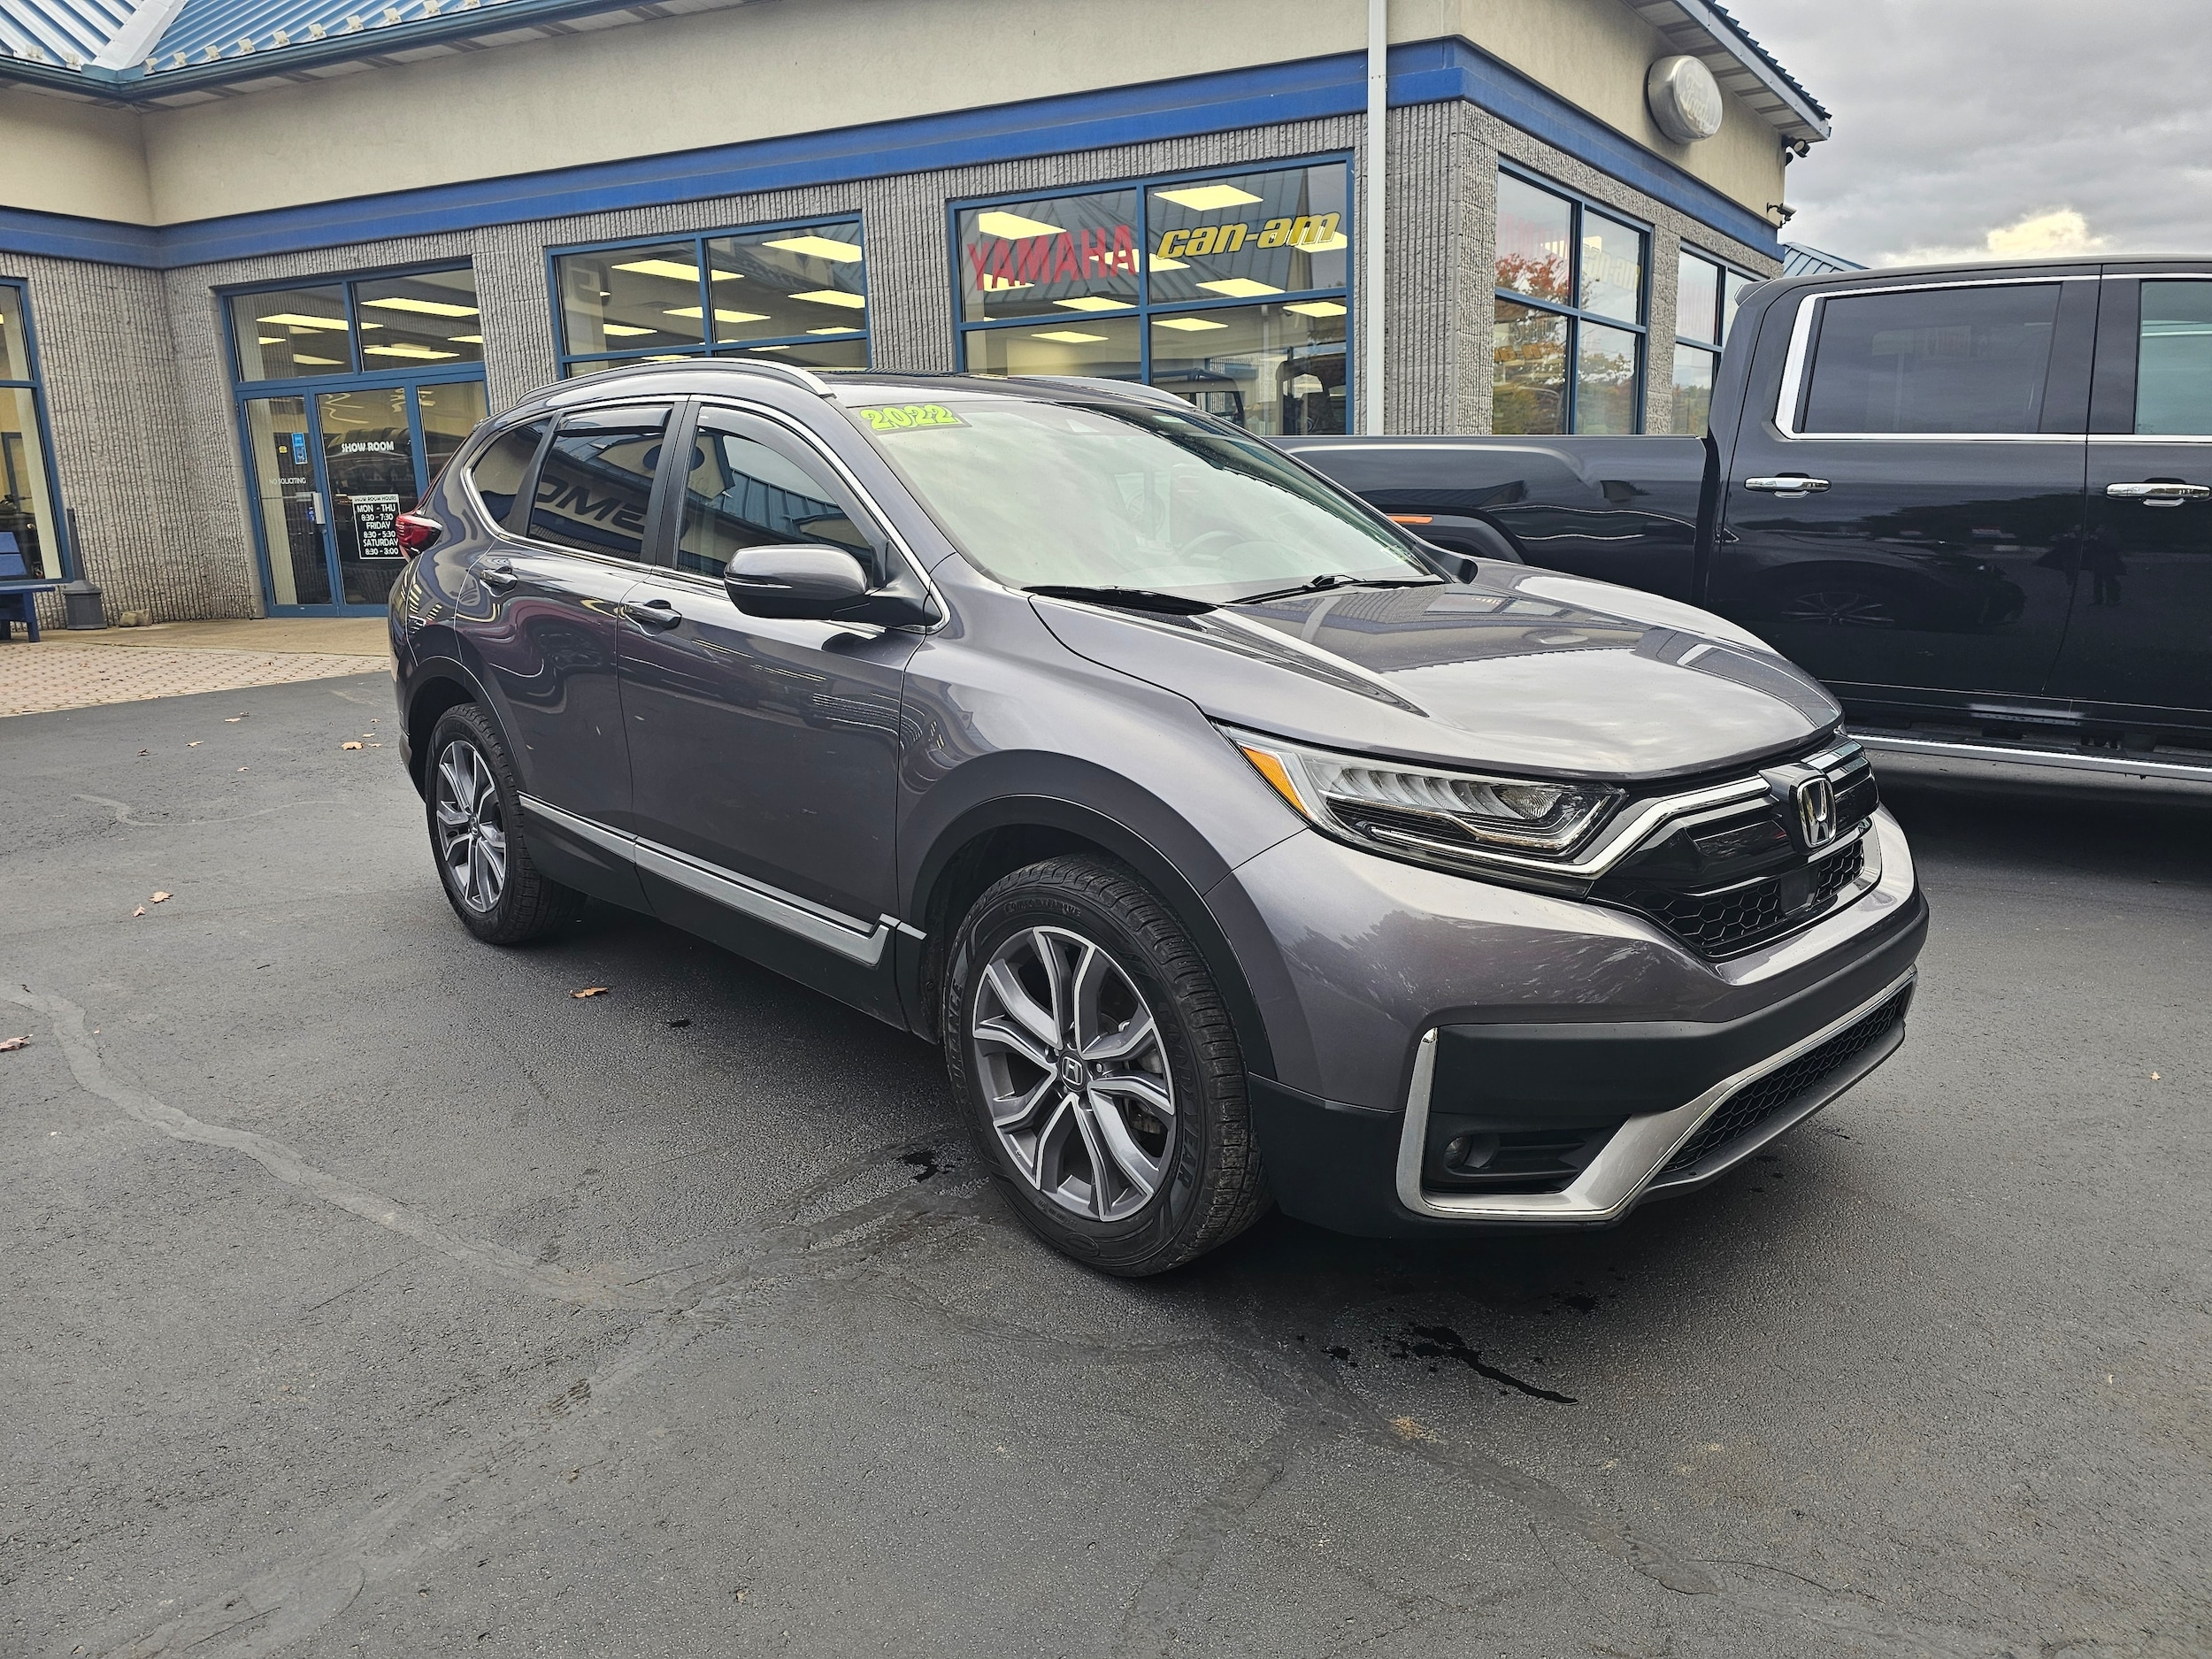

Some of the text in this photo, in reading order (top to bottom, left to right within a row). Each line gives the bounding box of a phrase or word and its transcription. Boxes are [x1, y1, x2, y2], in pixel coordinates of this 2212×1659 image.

[1156, 211, 1340, 259] can-am
[967, 225, 1135, 291] YAMAHA
[860, 404, 960, 431] 2022
[342, 442, 394, 453] SHOW ROOM
[366, 521, 390, 530] FRIDAY
[363, 538, 398, 547] SATURDAY
